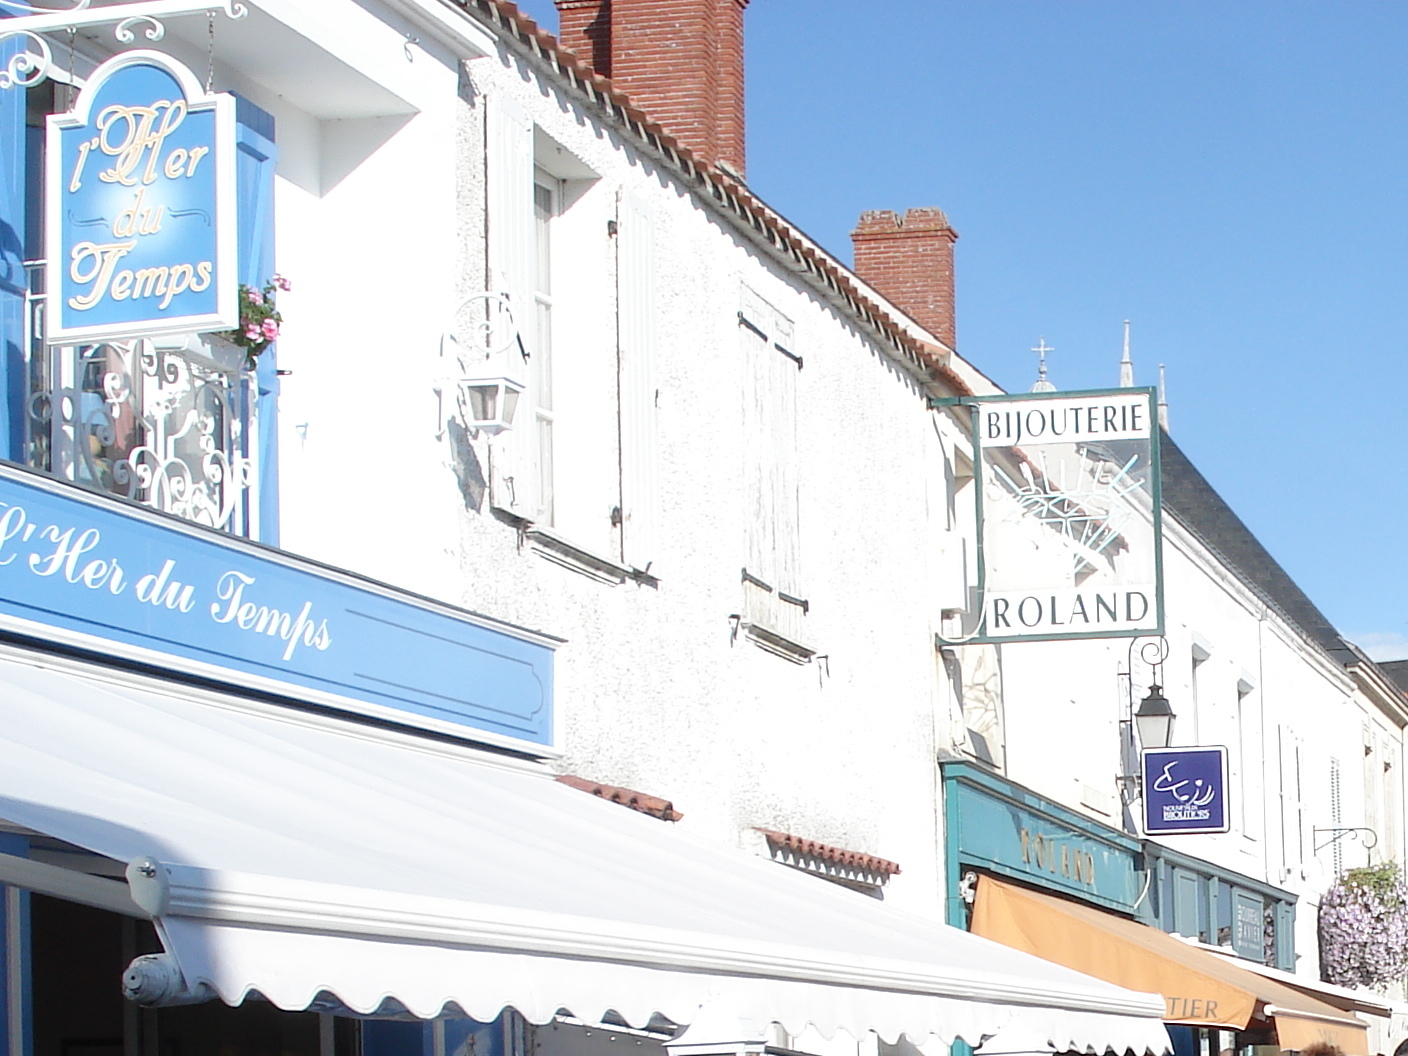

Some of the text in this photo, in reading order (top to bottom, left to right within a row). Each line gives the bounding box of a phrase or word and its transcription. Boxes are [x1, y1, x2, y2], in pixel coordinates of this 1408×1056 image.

[69, 99, 209, 192] l'Her
[113, 188, 164, 238] du
[68, 240, 212, 311] Temps
[987, 404, 1143, 445] BIJOUTERIE
[136, 559, 195, 613] du
[211, 570, 332, 661] Temps
[993, 591, 1149, 628] ROLAND
[1166, 997, 1219, 1019] TIER
